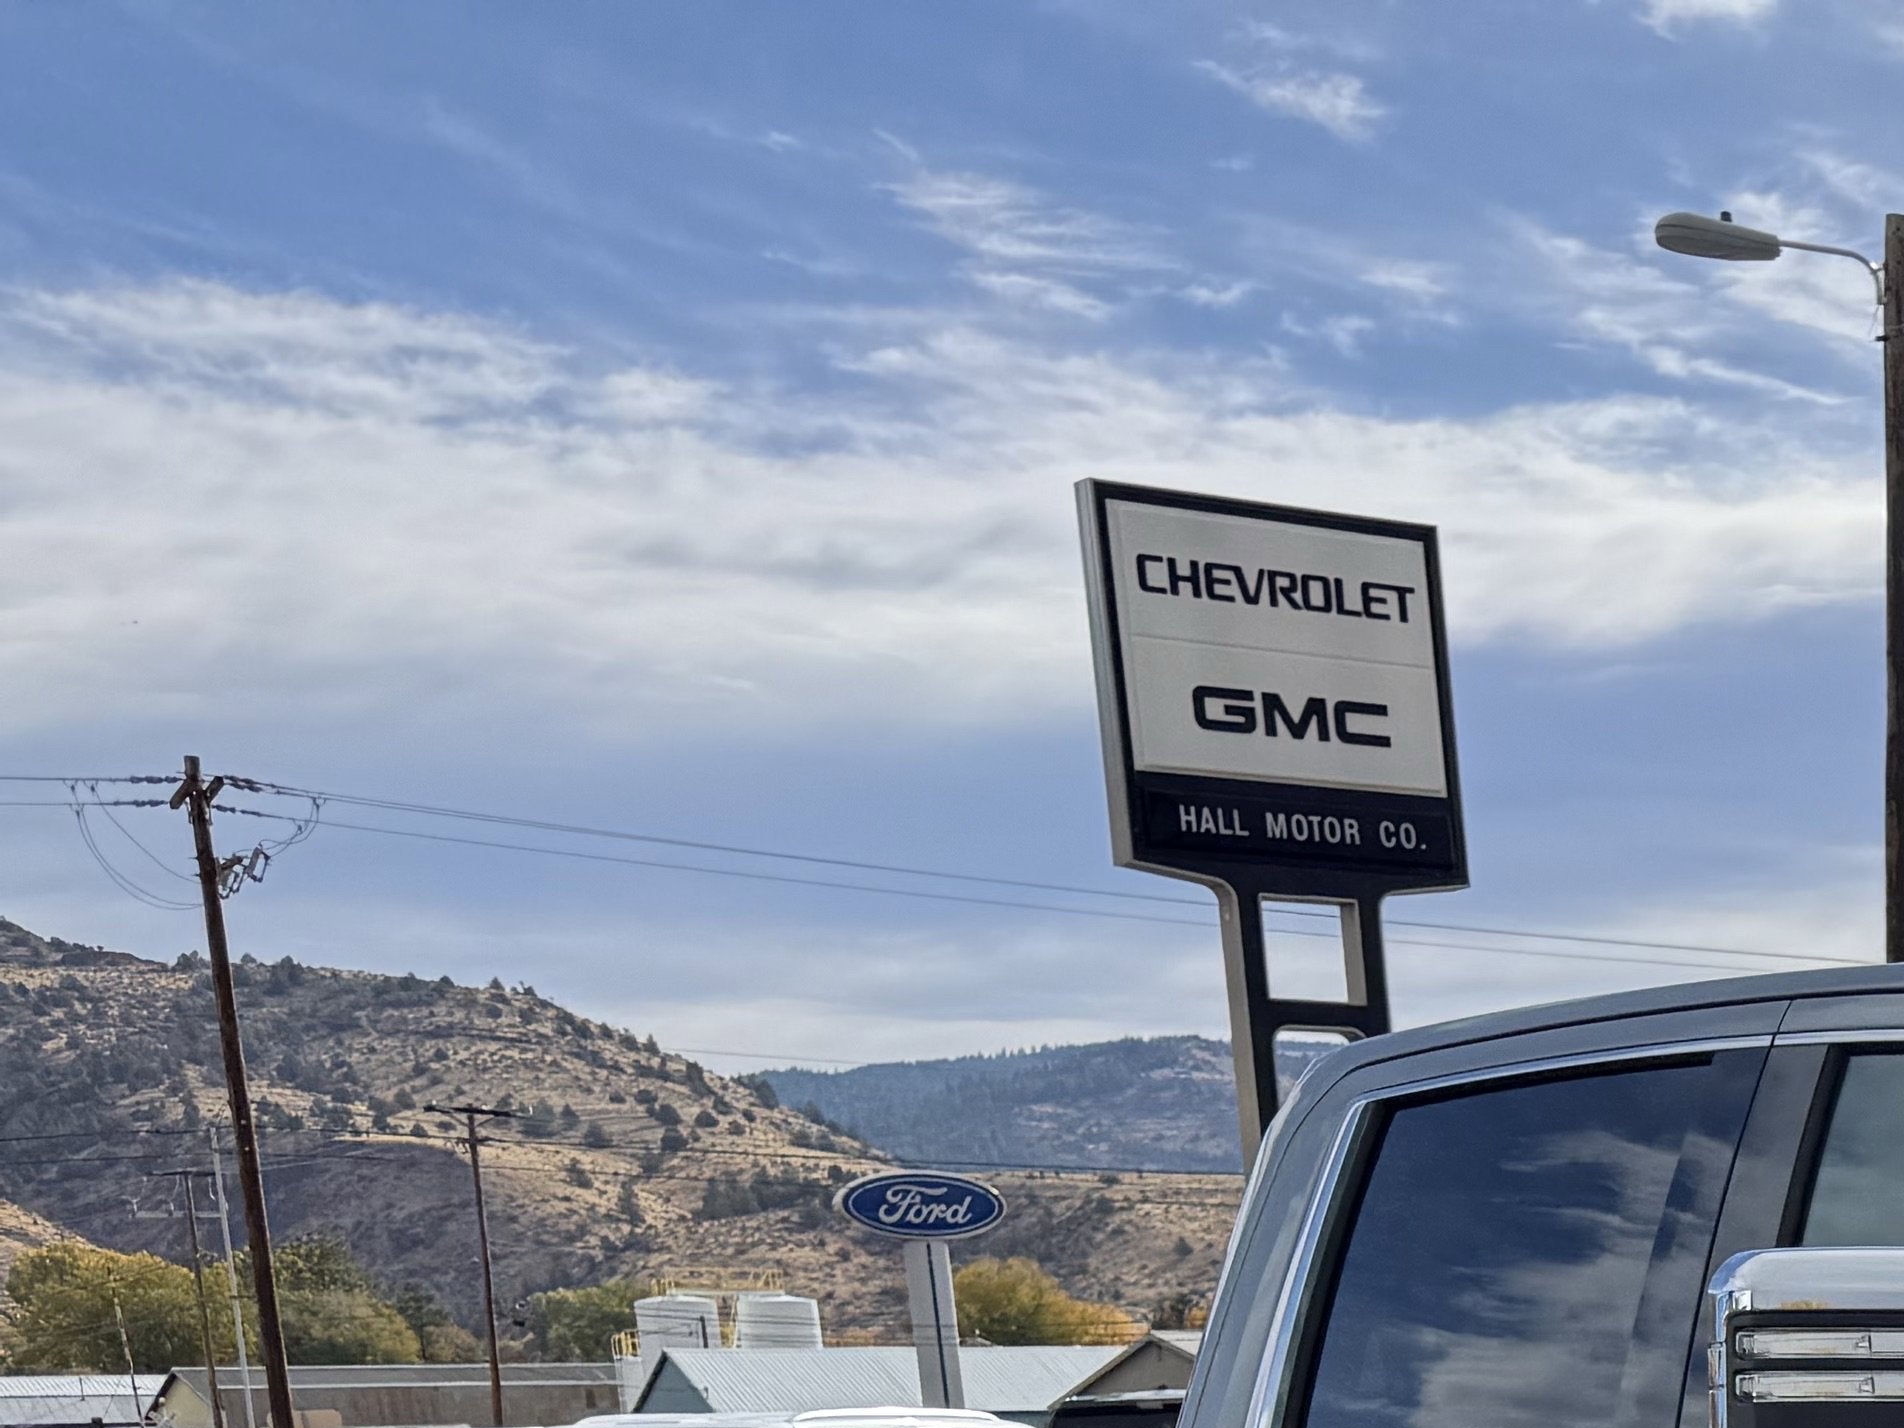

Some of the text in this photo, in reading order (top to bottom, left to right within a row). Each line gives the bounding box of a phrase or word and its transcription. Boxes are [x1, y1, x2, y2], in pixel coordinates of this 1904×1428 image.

[1136, 553, 1415, 623] CHEVROLET
[1192, 685, 1391, 748] GMC
[1178, 804, 1427, 851] HALL MOTOR CO.
[878, 1184, 973, 1224] Ford
